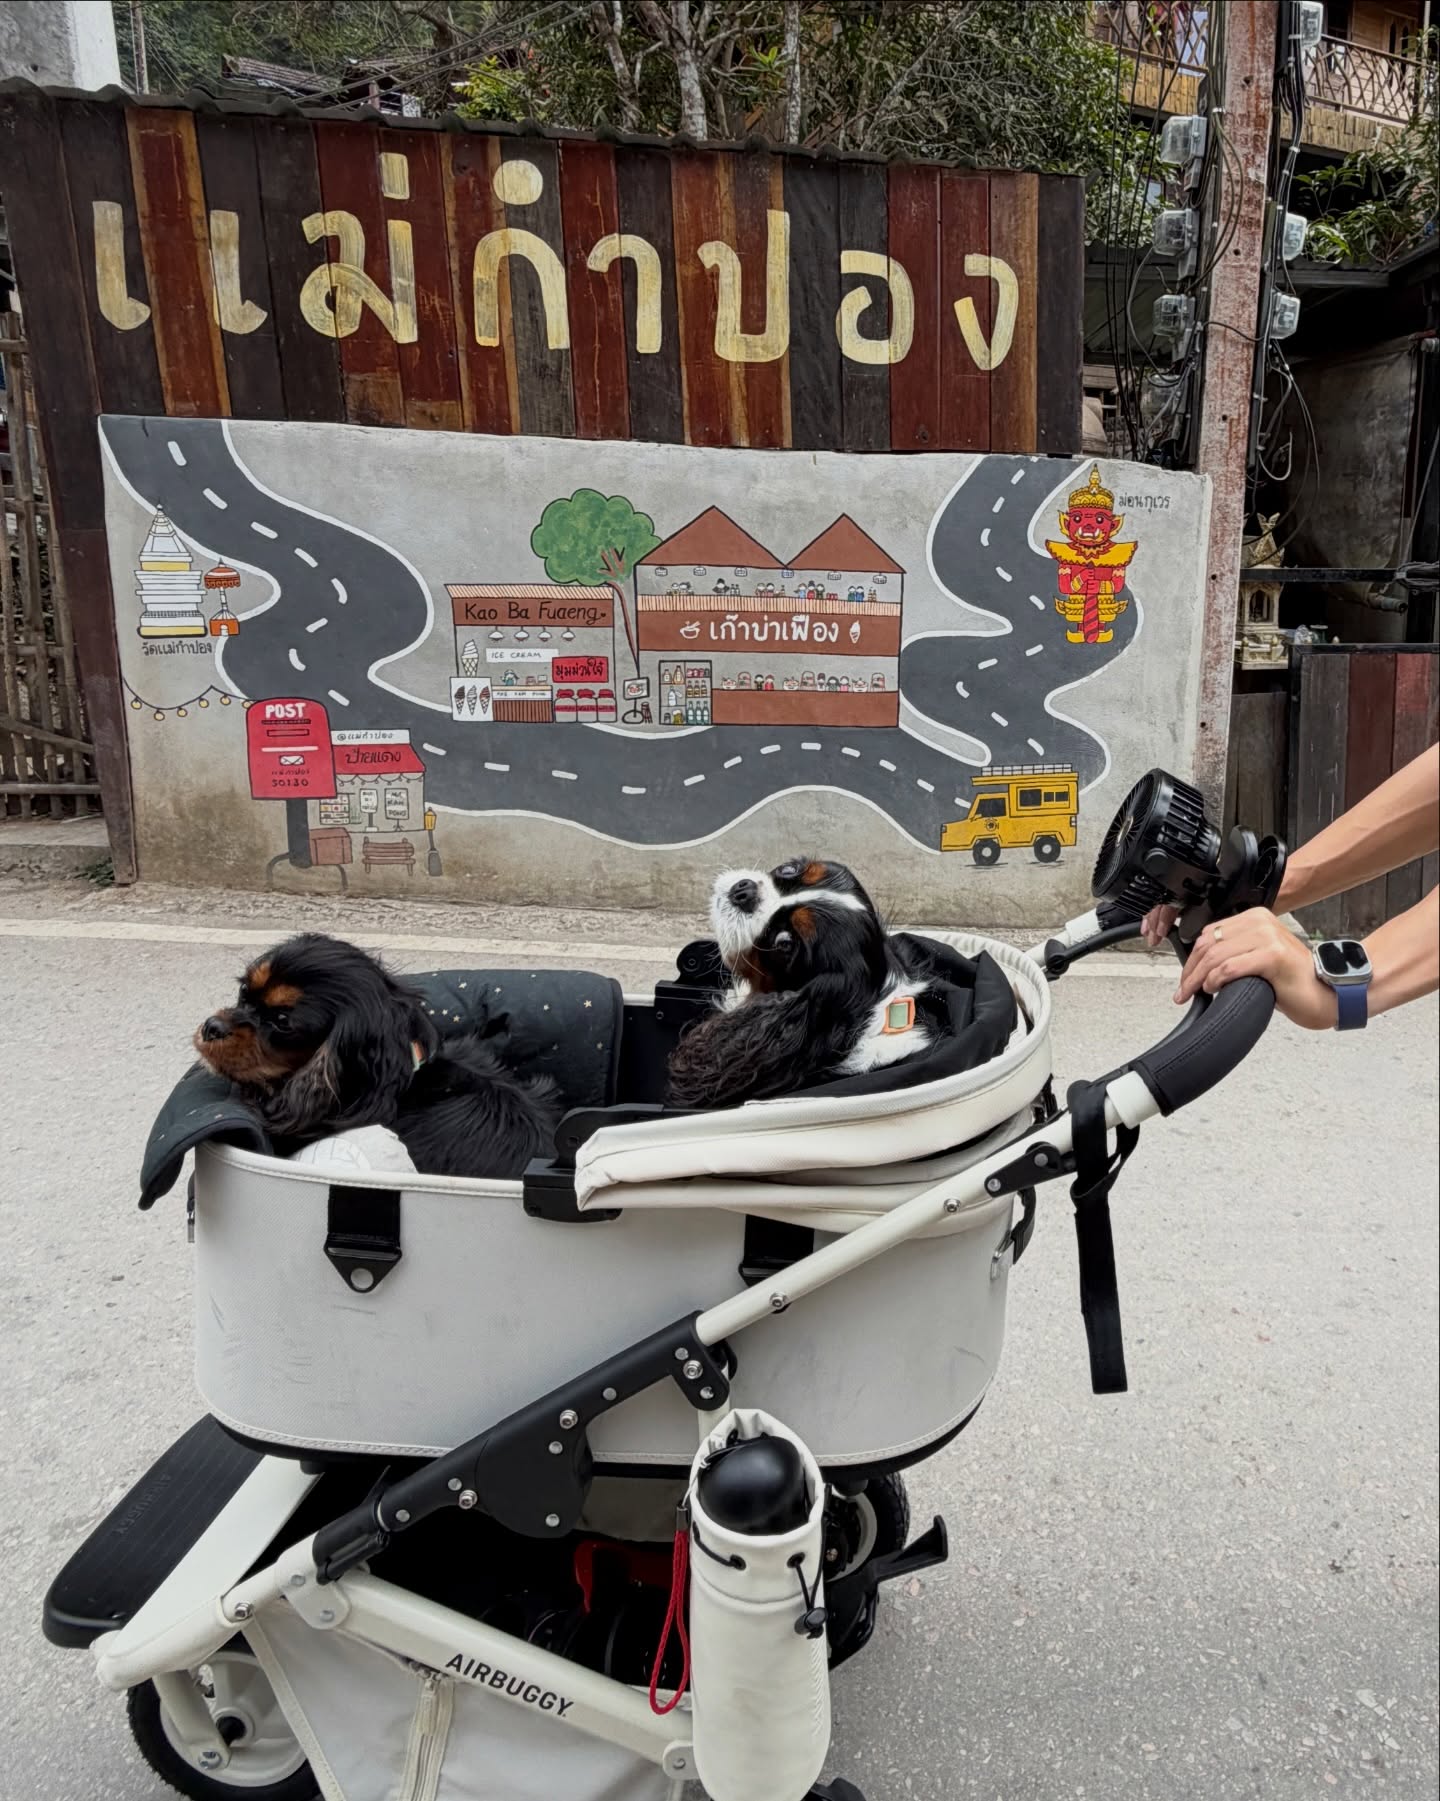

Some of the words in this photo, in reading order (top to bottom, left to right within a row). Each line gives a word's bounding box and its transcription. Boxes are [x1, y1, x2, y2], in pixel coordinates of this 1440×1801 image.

[93, 152, 1019, 370] แม่กำปอง
[465, 602, 498, 621] Kao
[508, 601, 530, 620] Ba
[539, 601, 601, 626] Fuaeng
[710, 614, 839, 643] เก๊าบ่าเฟือง
[141, 640, 212, 656] วัดแม่กำปอง
[265, 702, 307, 719] POST
[445, 1653, 574, 1717] AIRBUGGY
